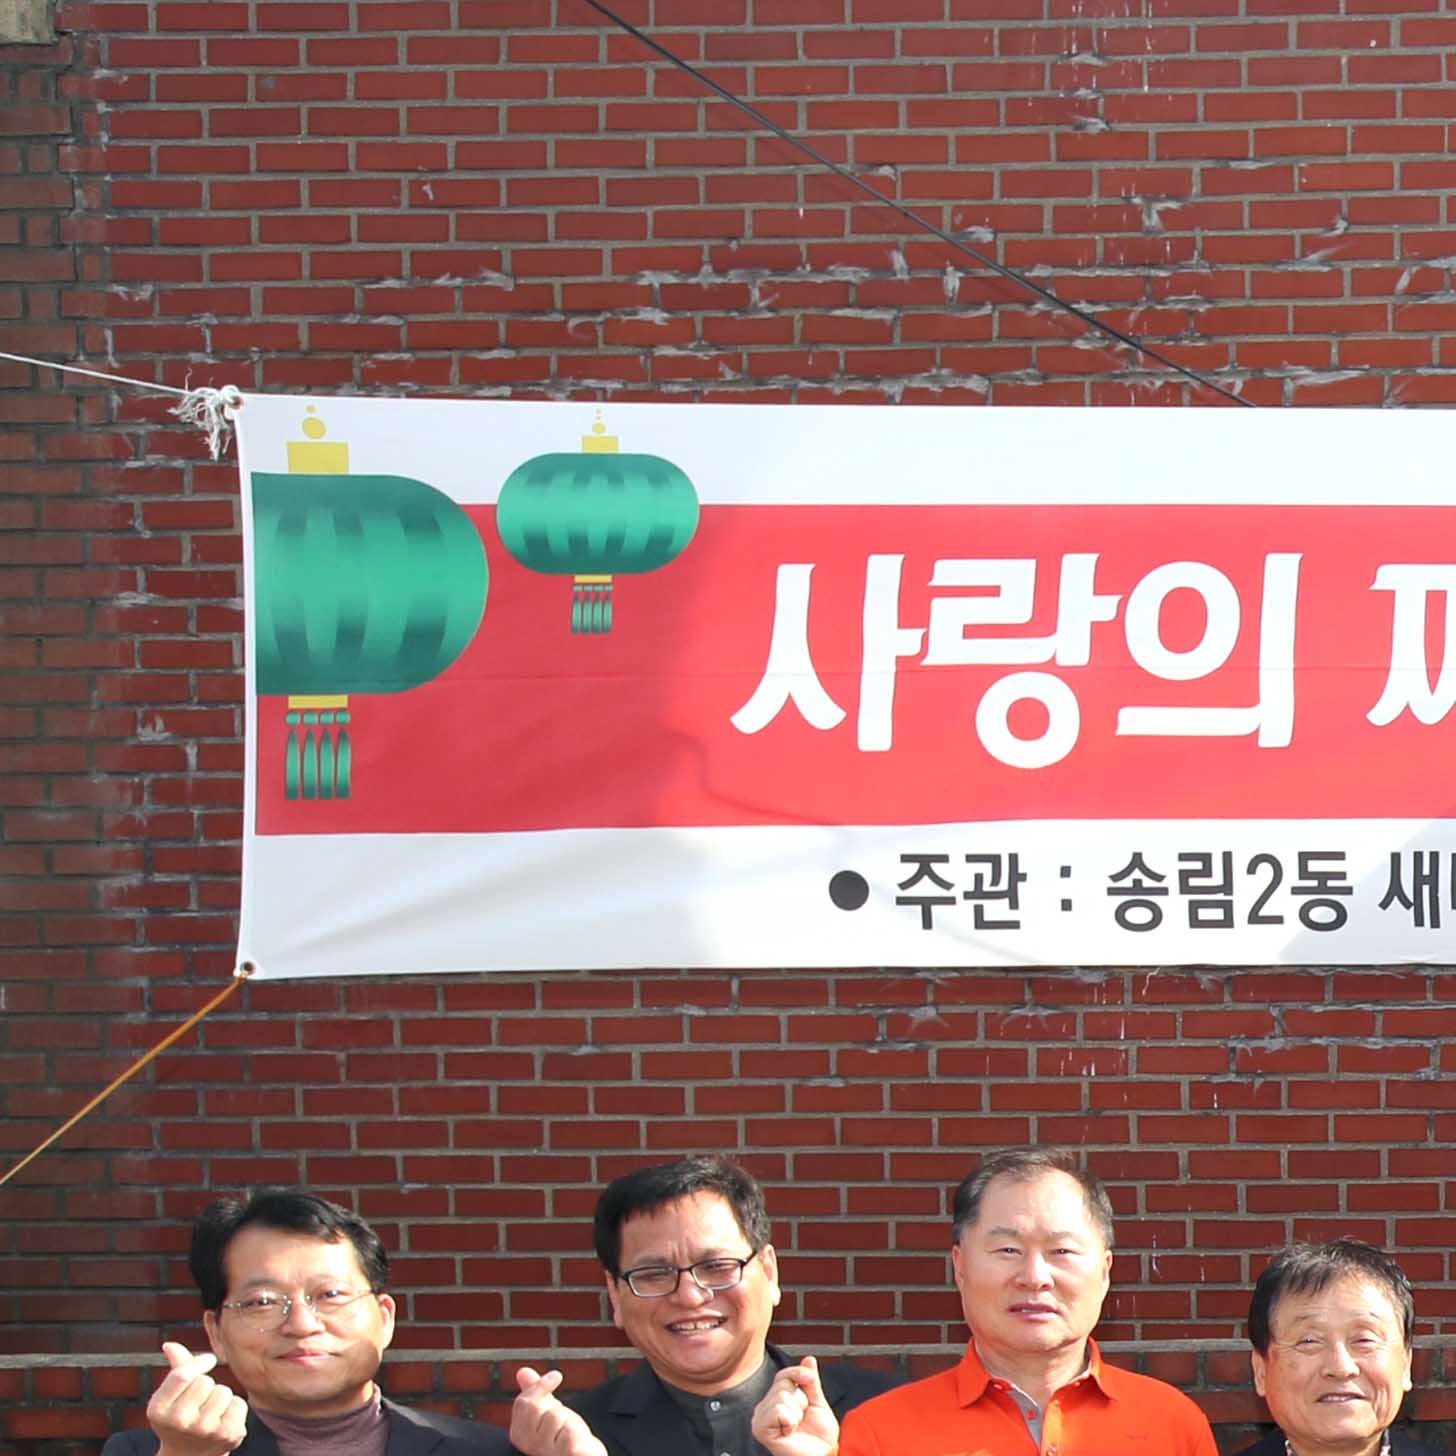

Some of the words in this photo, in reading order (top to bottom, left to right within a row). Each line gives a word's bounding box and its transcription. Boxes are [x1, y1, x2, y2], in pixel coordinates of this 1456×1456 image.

[730, 553, 1304, 769] 사랑의
[895, 852, 1028, 931] 주관
[1105, 850, 1355, 932] 송림2동
